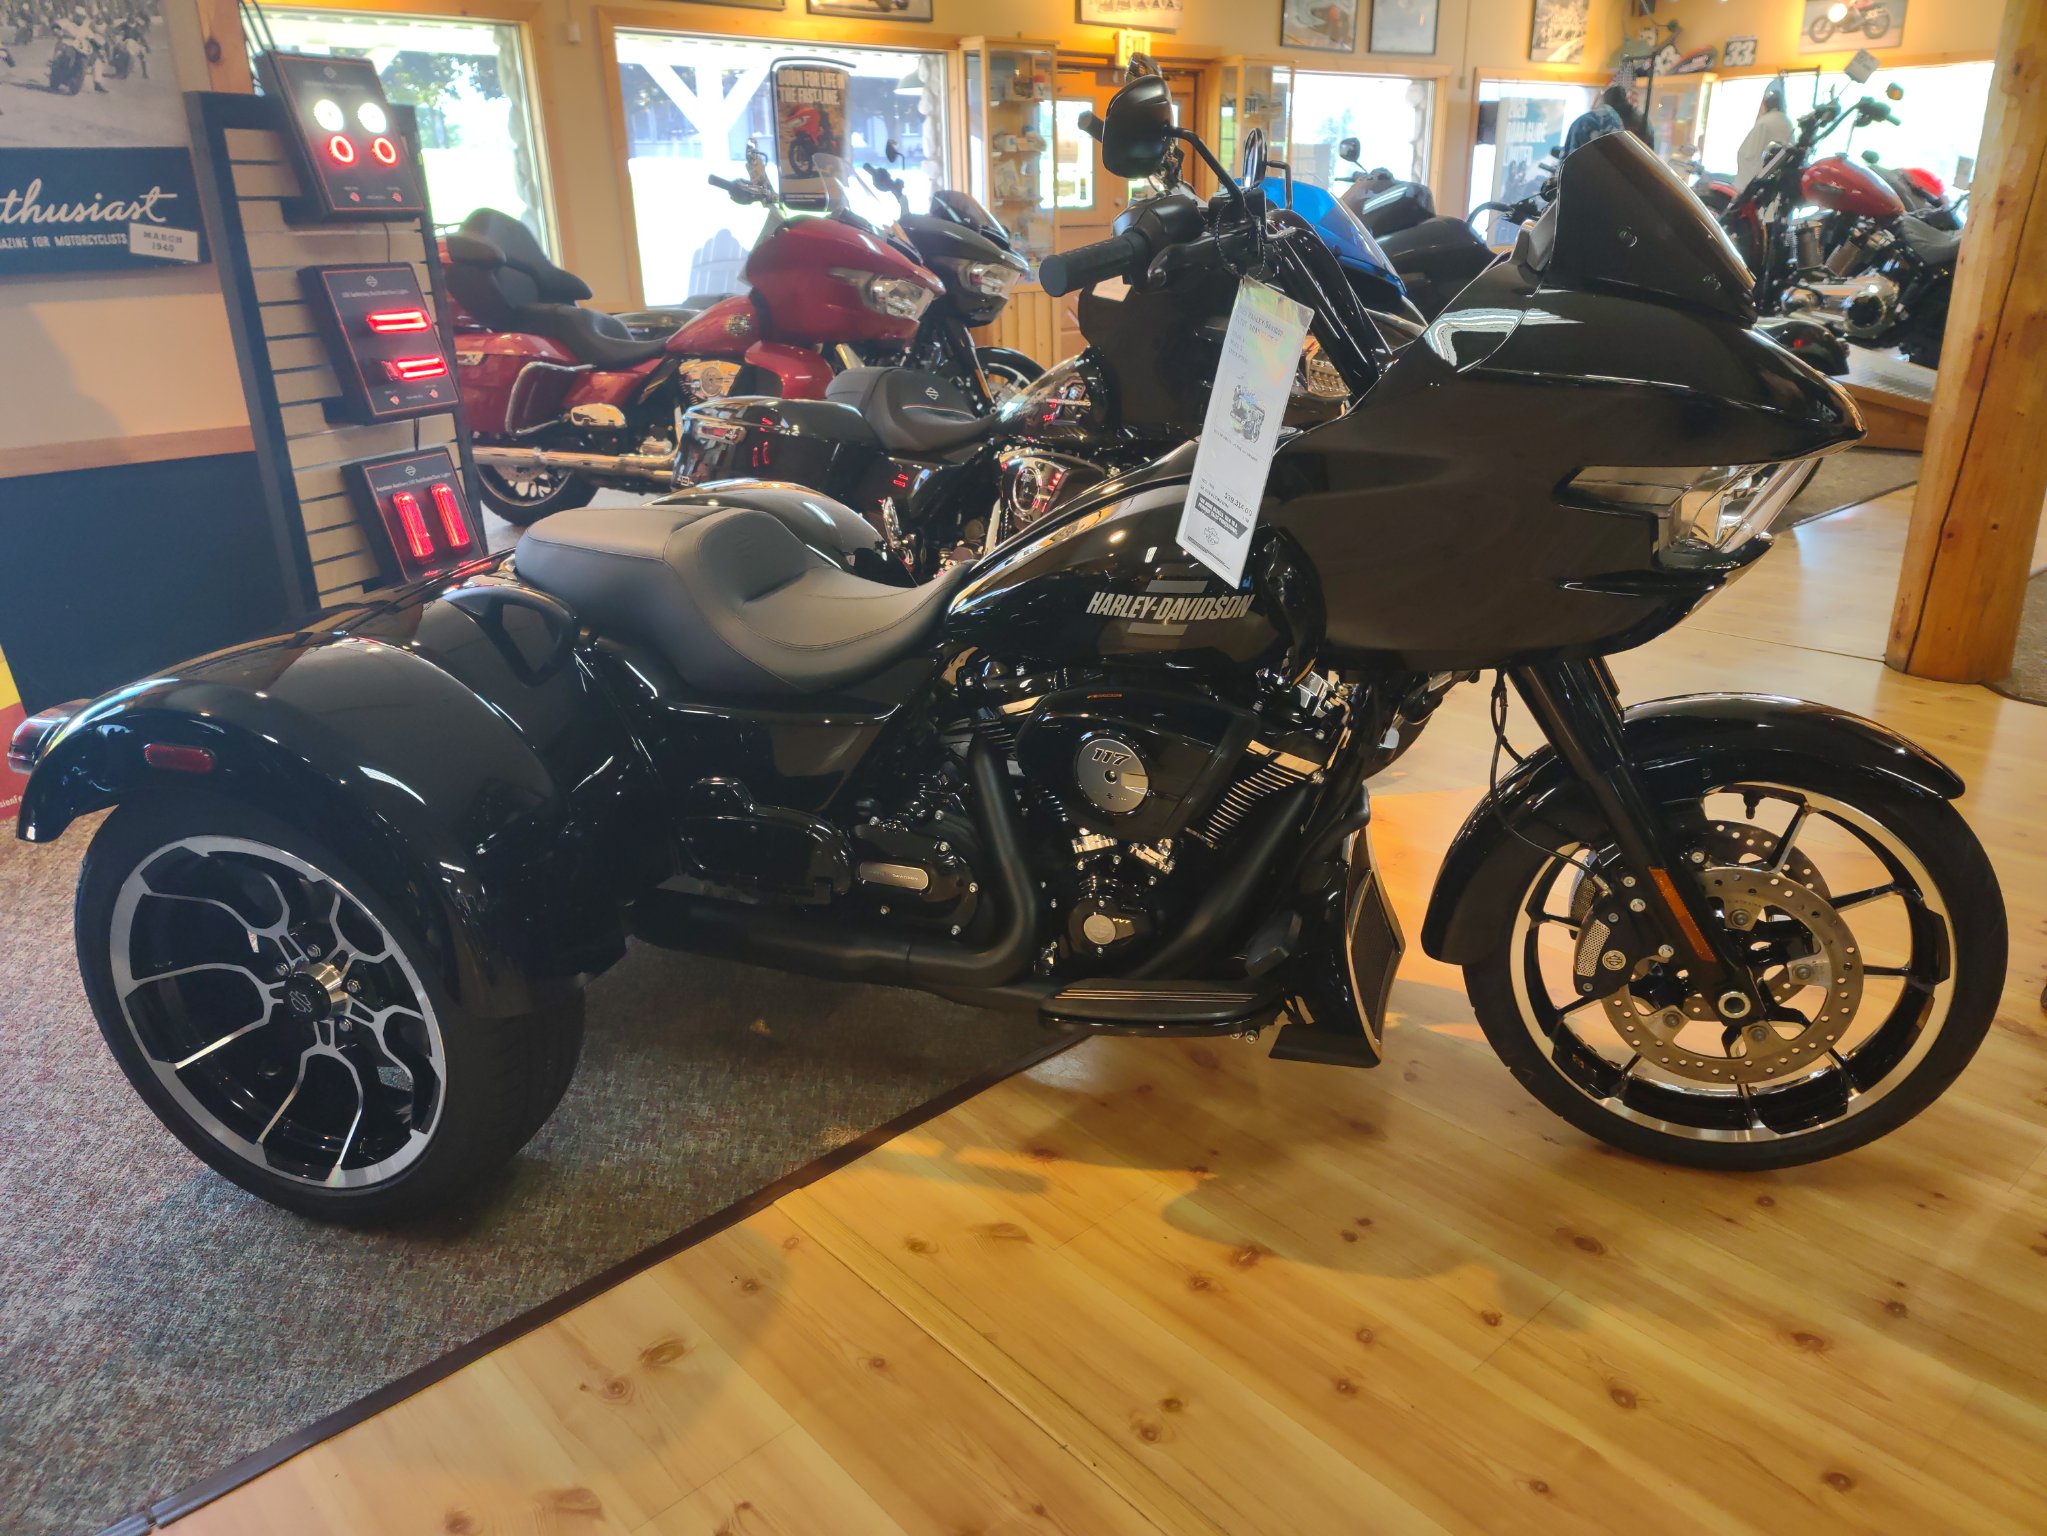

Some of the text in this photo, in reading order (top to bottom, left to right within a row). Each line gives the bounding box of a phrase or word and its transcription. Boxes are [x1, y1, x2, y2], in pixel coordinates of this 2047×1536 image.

[778, 87, 797, 103] THE
[32, 236, 51, 247] FOR
[54, 233, 128, 246] MOTORCYCLISTS
[143, 231, 183, 244] MARCH
[1085, 591, 1256, 621] HARLEY-DAVIDSON
[1091, 747, 1132, 766] 117
